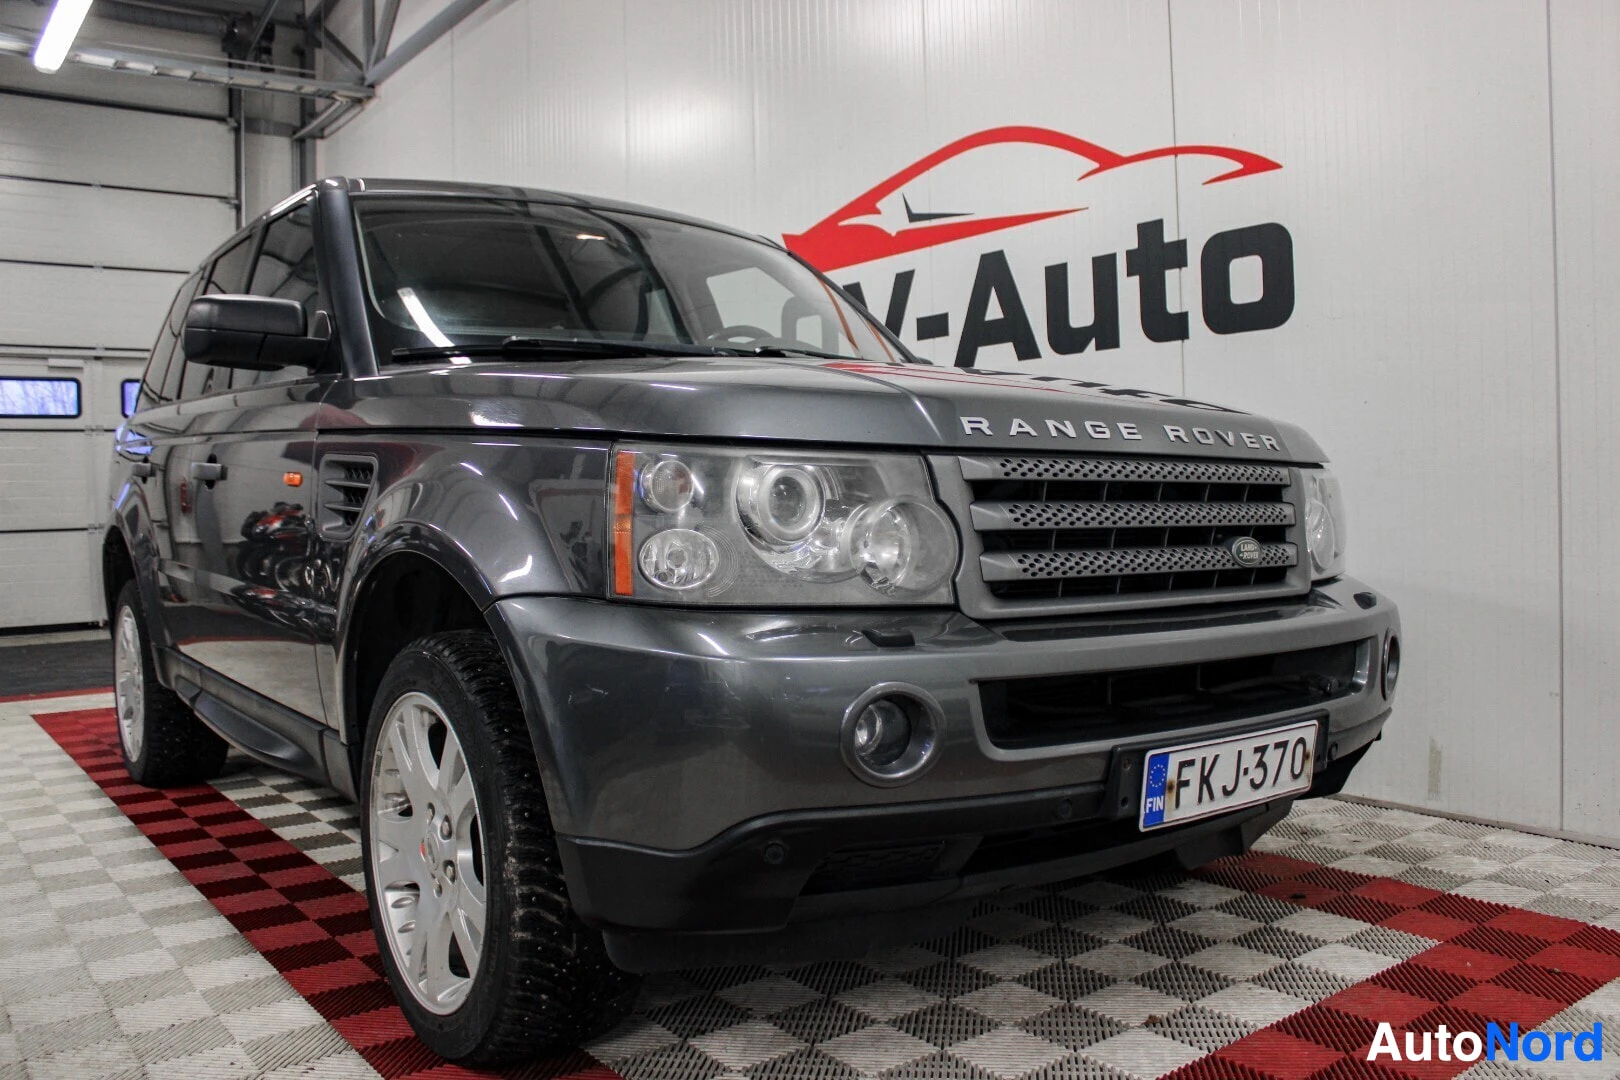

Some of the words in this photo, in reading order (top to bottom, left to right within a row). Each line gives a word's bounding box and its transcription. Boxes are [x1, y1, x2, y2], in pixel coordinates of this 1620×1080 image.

[959, 416, 1143, 440] RANGE
[1163, 424, 1282, 451] ROVER
[1175, 736, 1307, 810] FKJ-370
[1146, 795, 1165, 814] FIN
